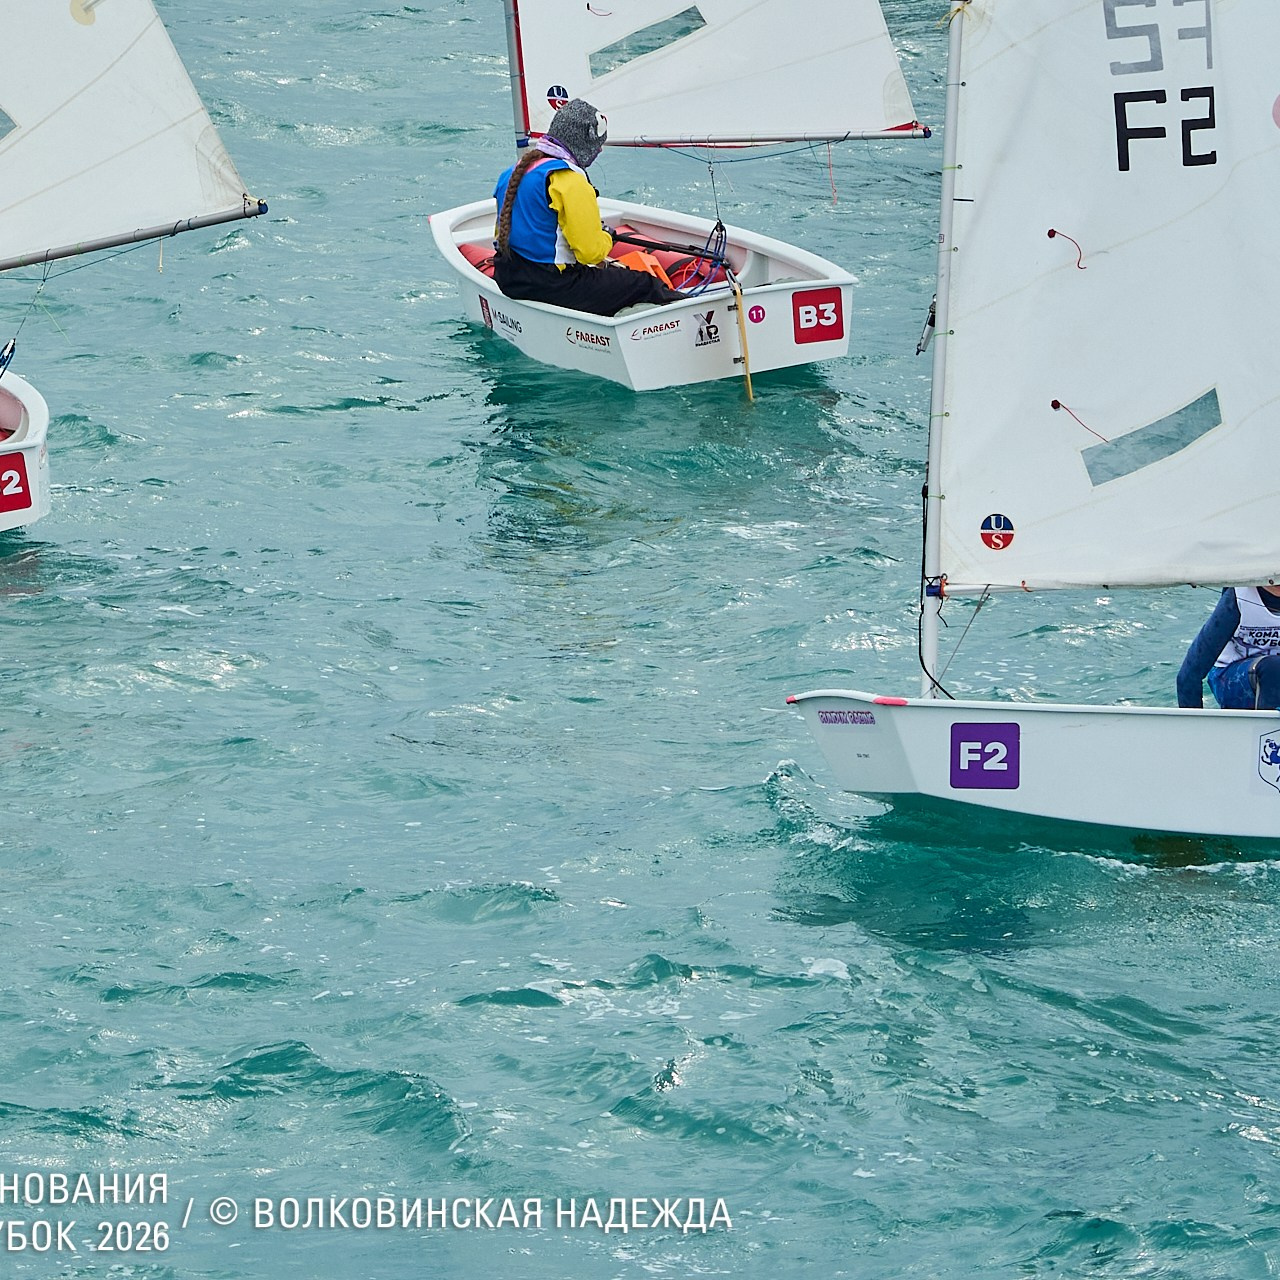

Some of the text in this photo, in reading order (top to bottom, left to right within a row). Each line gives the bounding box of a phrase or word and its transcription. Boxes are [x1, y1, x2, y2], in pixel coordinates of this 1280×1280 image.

[1114, 86, 1217, 171] F2
[751, 310, 764, 320] 11
[799, 303, 837, 329] B3
[642, 320, 681, 335] FAREAST
[575, 331, 611, 347] FAREAST
[960, 741, 1008, 770] F2
